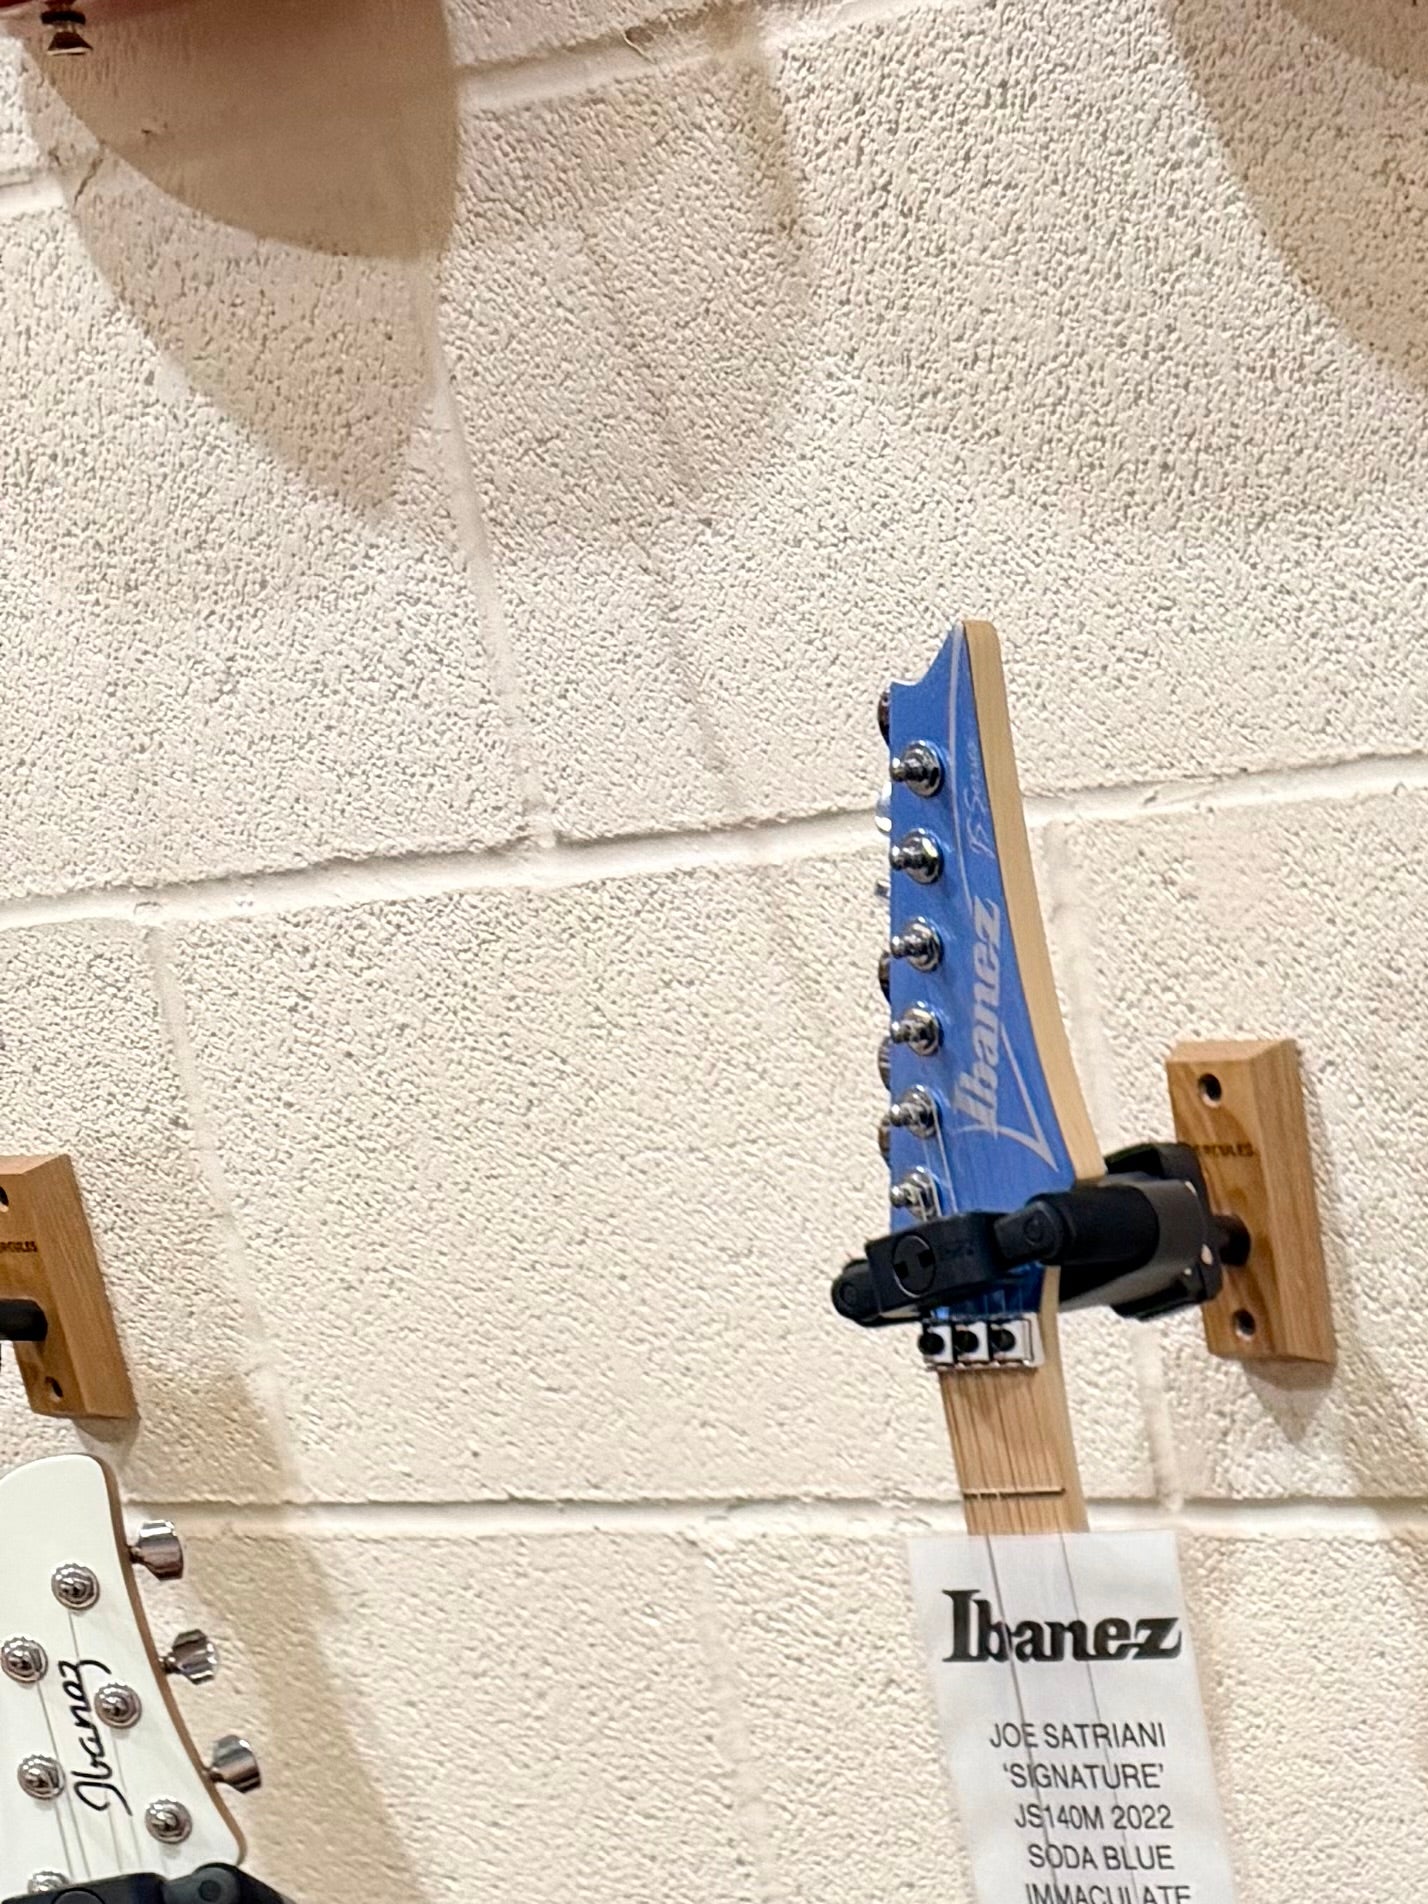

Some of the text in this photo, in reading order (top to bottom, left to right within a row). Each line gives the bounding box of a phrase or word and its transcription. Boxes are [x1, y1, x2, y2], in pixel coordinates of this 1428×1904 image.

[954, 895, 1000, 1140] Ibanez
[941, 1588, 1183, 1663] Ibanez
[990, 1723, 1167, 1749] JOE SATRIANI
[1014, 1804, 1174, 1831] JS140M 2022
[1028, 1844, 1175, 1871] SODA BLUE
